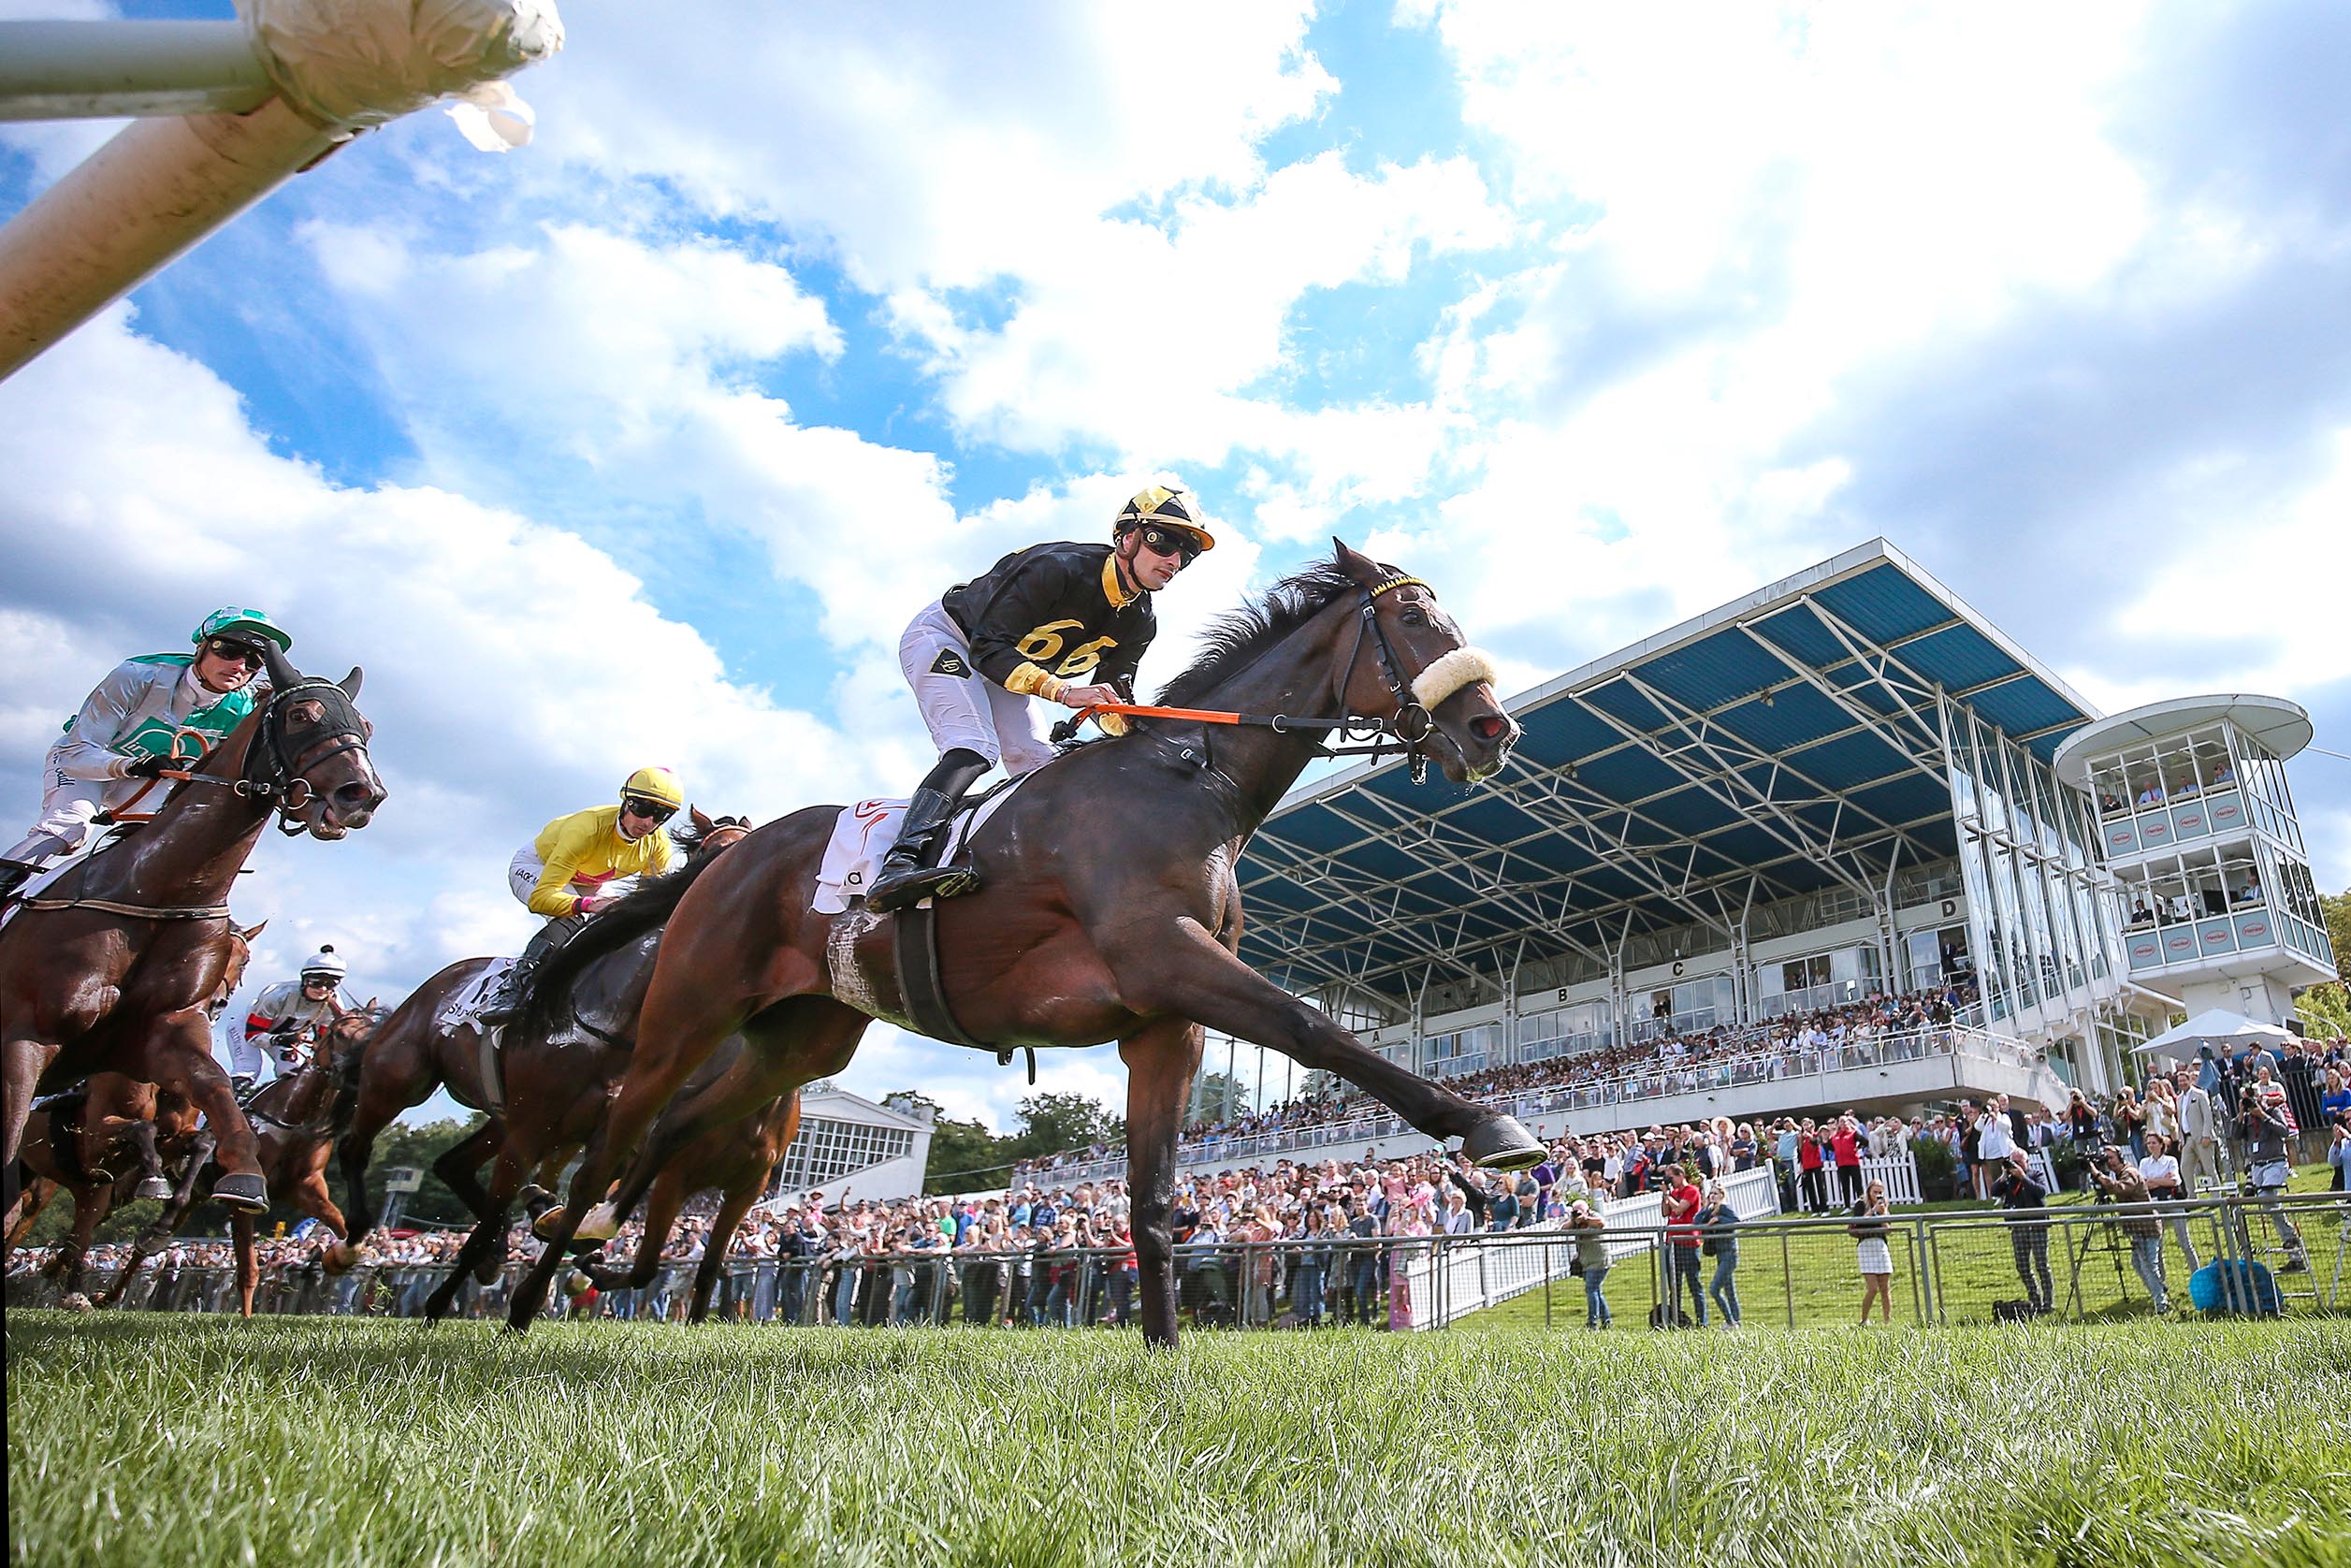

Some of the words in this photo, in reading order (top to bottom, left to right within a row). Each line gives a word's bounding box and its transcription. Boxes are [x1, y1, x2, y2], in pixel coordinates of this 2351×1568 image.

[1941, 900, 1957, 918] D
[1672, 962, 1684, 977] C
[1558, 988, 1568, 1002] B
[1371, 1030, 1381, 1043] A
